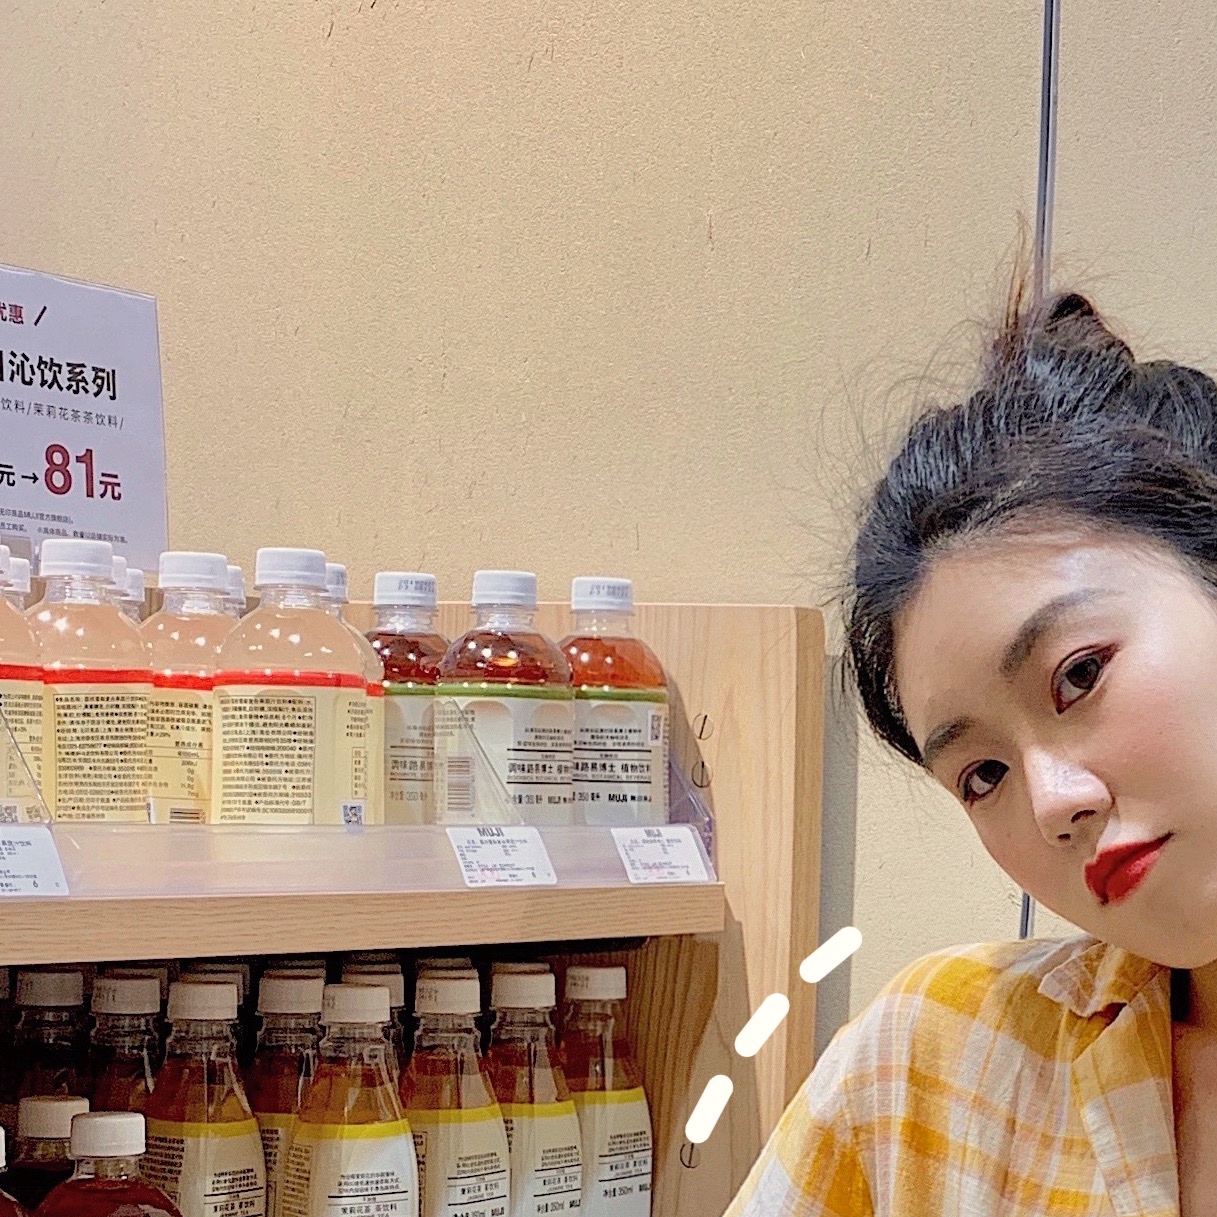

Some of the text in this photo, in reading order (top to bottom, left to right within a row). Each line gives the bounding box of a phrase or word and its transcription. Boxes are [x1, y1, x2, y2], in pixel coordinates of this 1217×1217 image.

[0, 350, 117, 400] 沁饮系列
[608, 793, 628, 803] MUJI
[477, 827, 504, 837] MUJI
